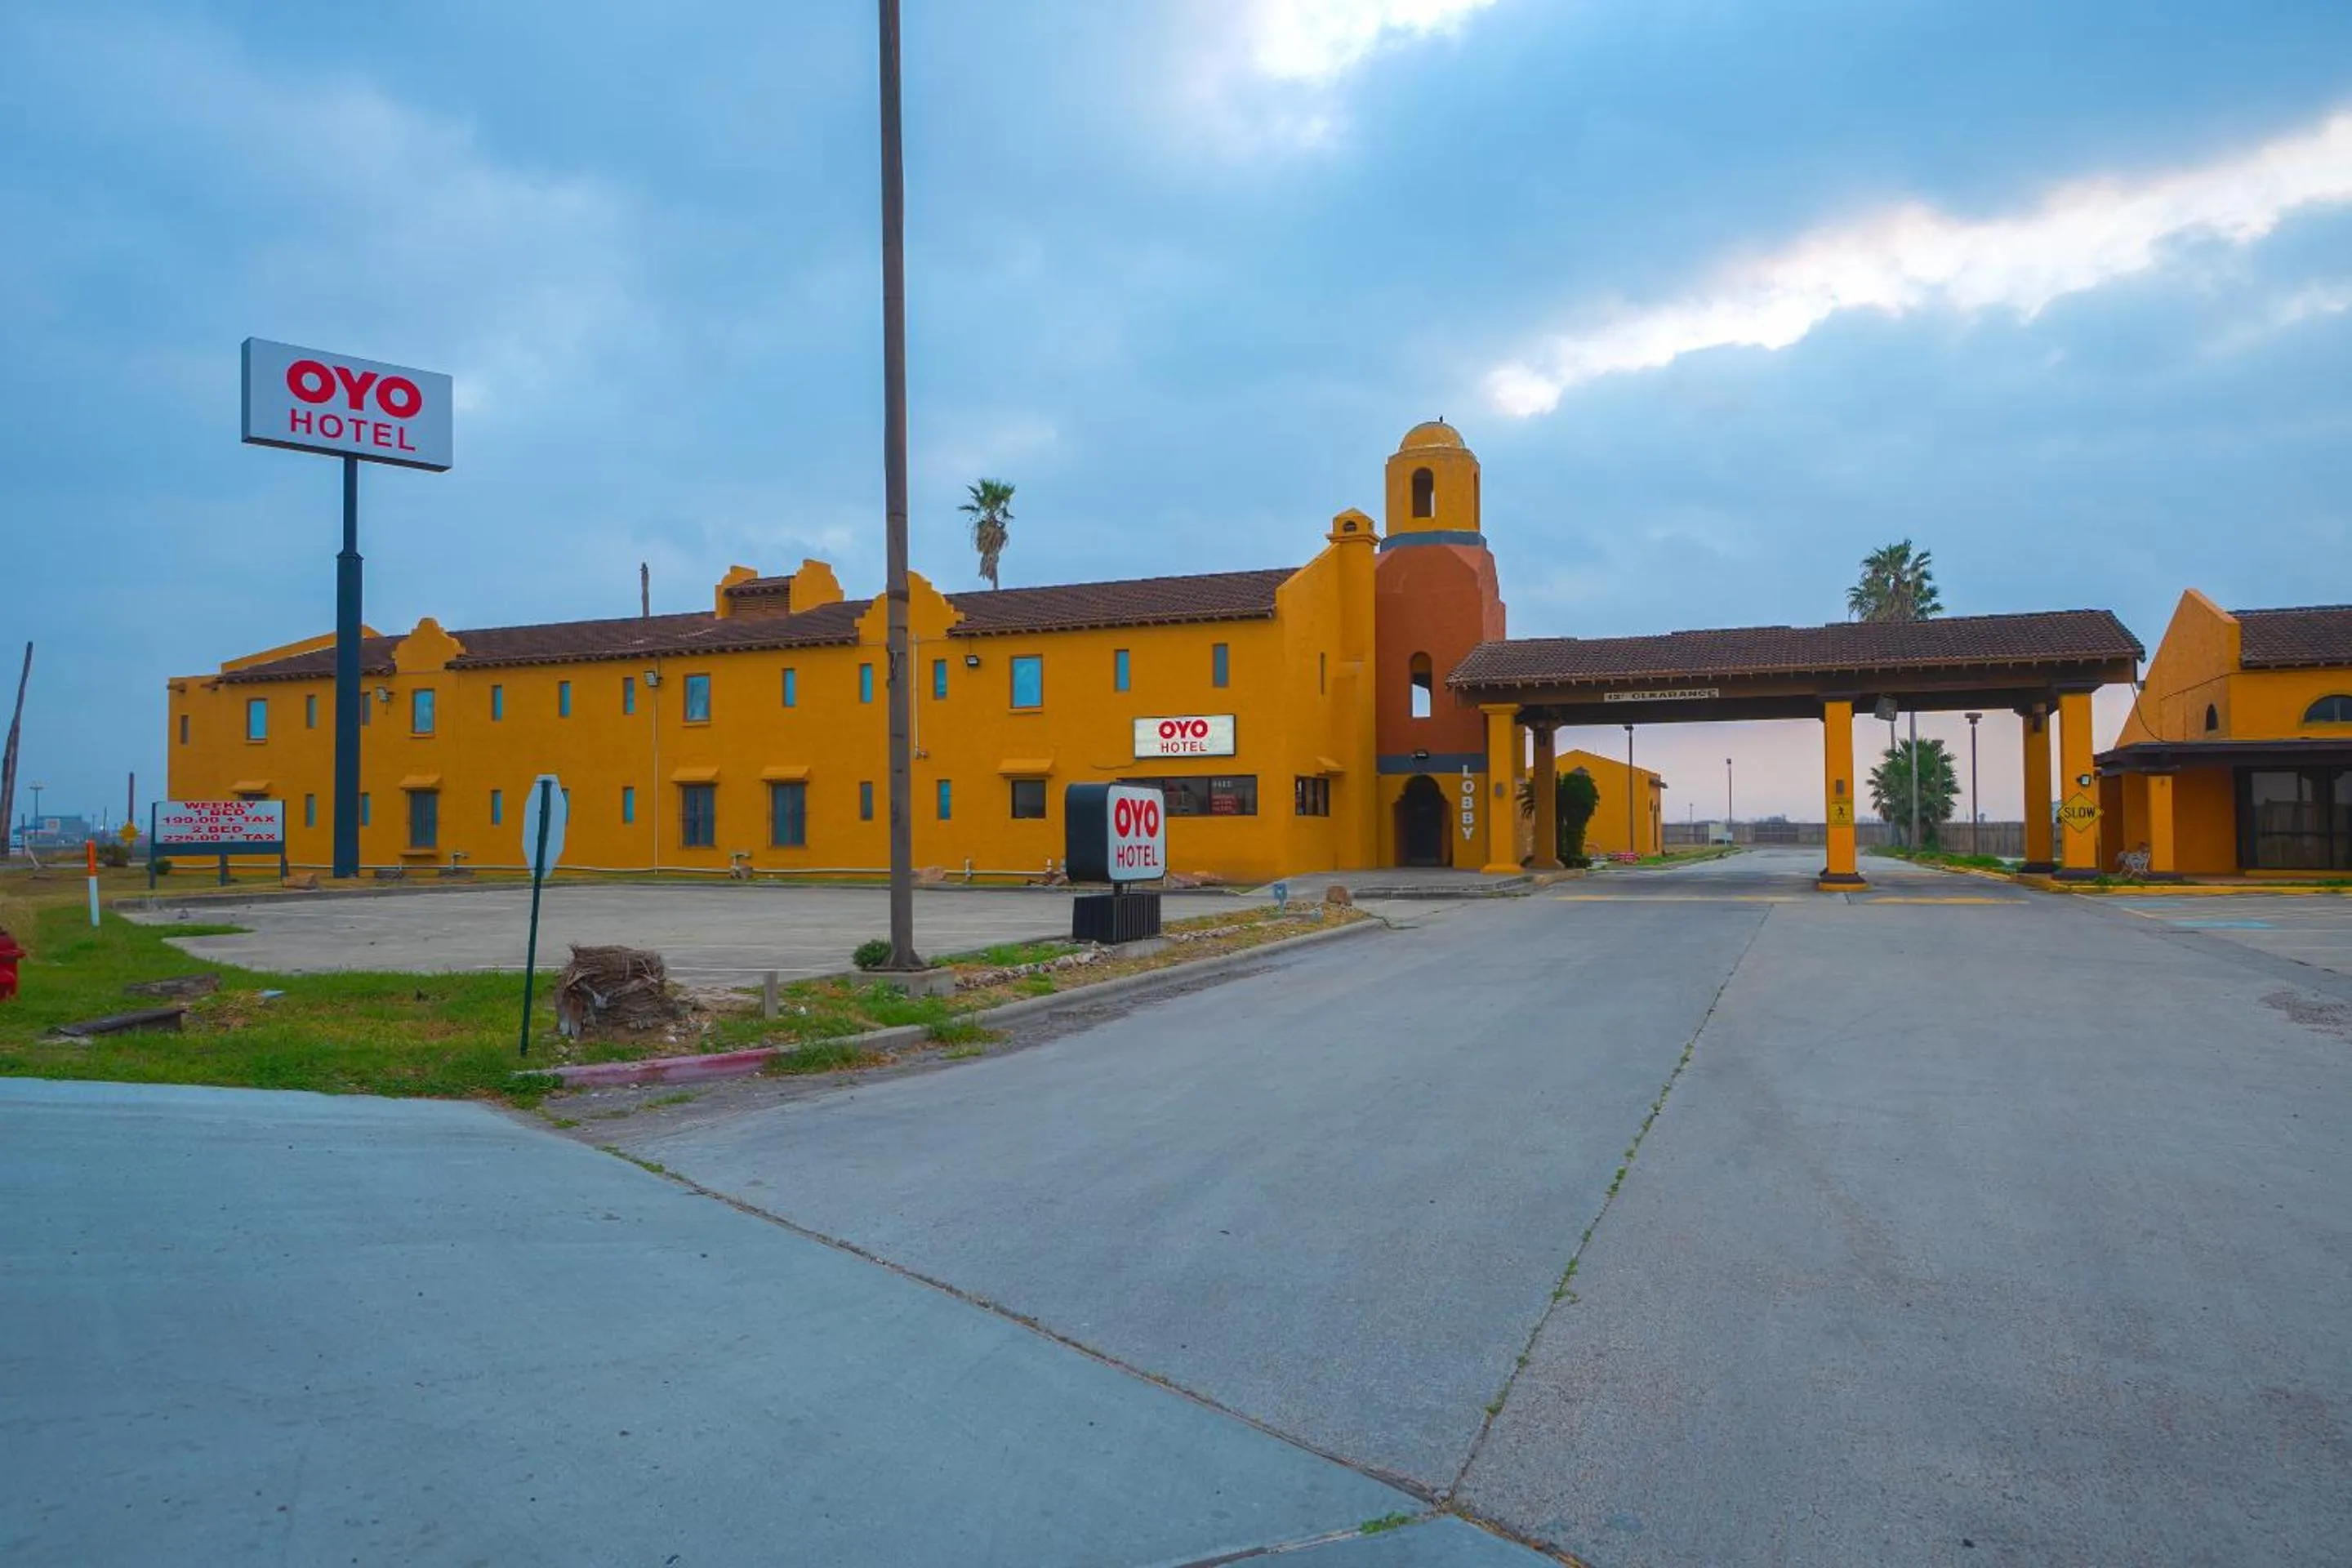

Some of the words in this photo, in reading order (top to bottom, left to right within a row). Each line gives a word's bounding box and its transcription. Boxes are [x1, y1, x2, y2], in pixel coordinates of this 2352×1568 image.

[287, 359, 423, 419] OYO
[290, 408, 416, 452] HOTEL
[1158, 719, 1209, 739] OYO
[1160, 741, 1207, 754] HOTEL
[184, 801, 256, 809] WEEKLY
[1461, 764, 1475, 840] LOBBY
[209, 808, 245, 817] BED
[243, 815, 275, 823] TAX
[1114, 797, 1160, 839] OYO
[2064, 806, 2096, 819] SLOW
[1116, 844, 1159, 868] HOTEL
